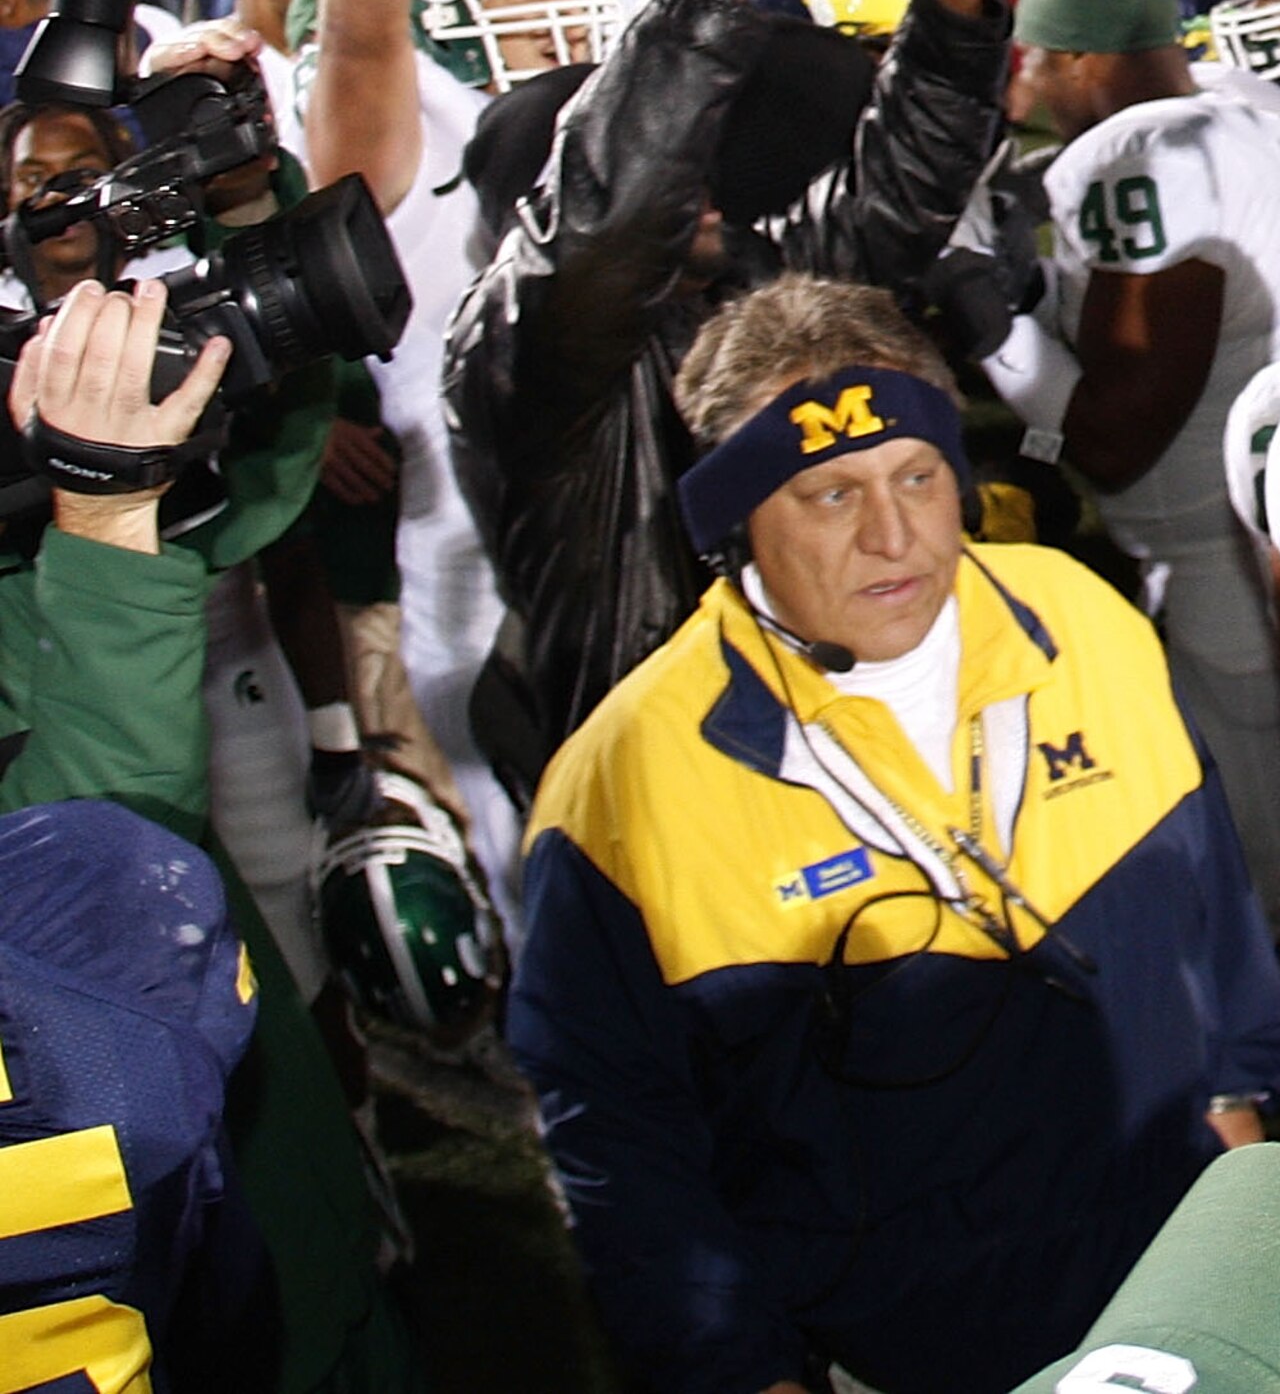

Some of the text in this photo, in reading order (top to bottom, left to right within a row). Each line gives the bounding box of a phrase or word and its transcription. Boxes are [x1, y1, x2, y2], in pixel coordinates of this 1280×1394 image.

[1079, 175, 1166, 262] 49
[790, 385, 884, 454] M
[1037, 731, 1095, 782] M
